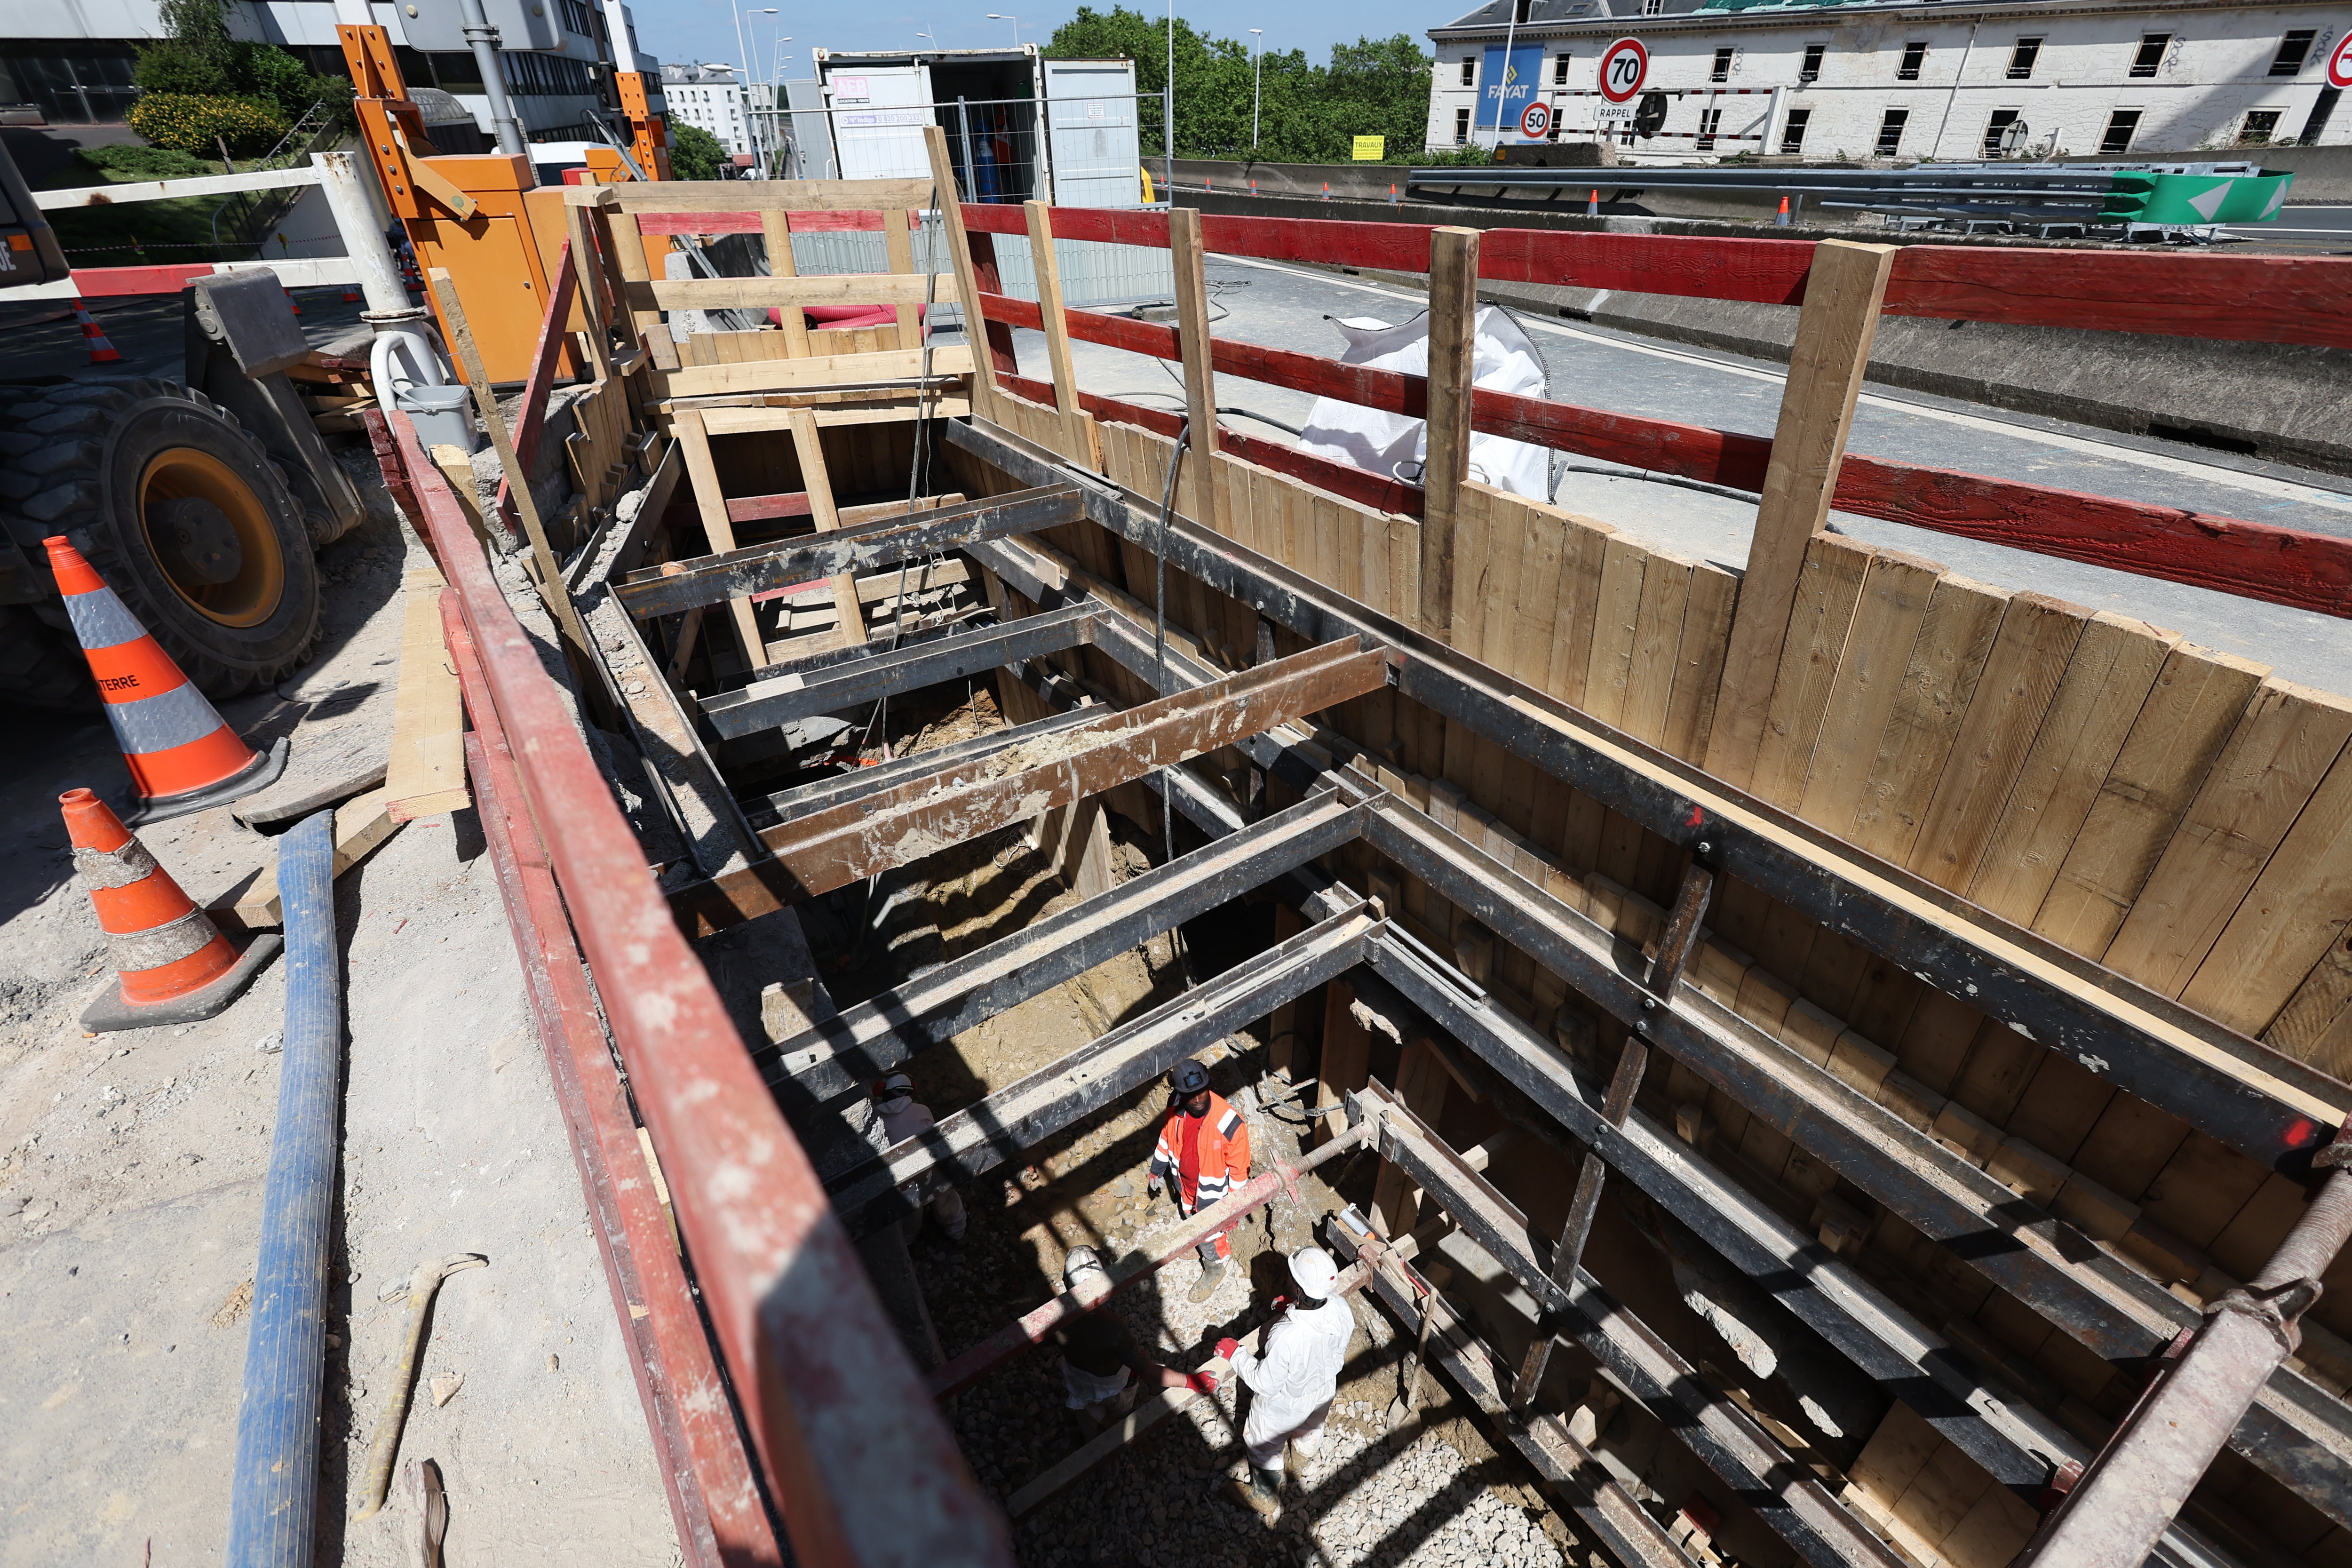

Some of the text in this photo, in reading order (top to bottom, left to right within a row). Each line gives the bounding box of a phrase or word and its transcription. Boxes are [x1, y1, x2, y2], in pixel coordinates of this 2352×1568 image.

[1613, 58, 1638, 84] 70
[837, 80, 867, 95] AEB
[1488, 85, 1529, 98] FAYAT
[1527, 113, 1545, 127] 50
[1600, 109, 1630, 118] RAPPEL
